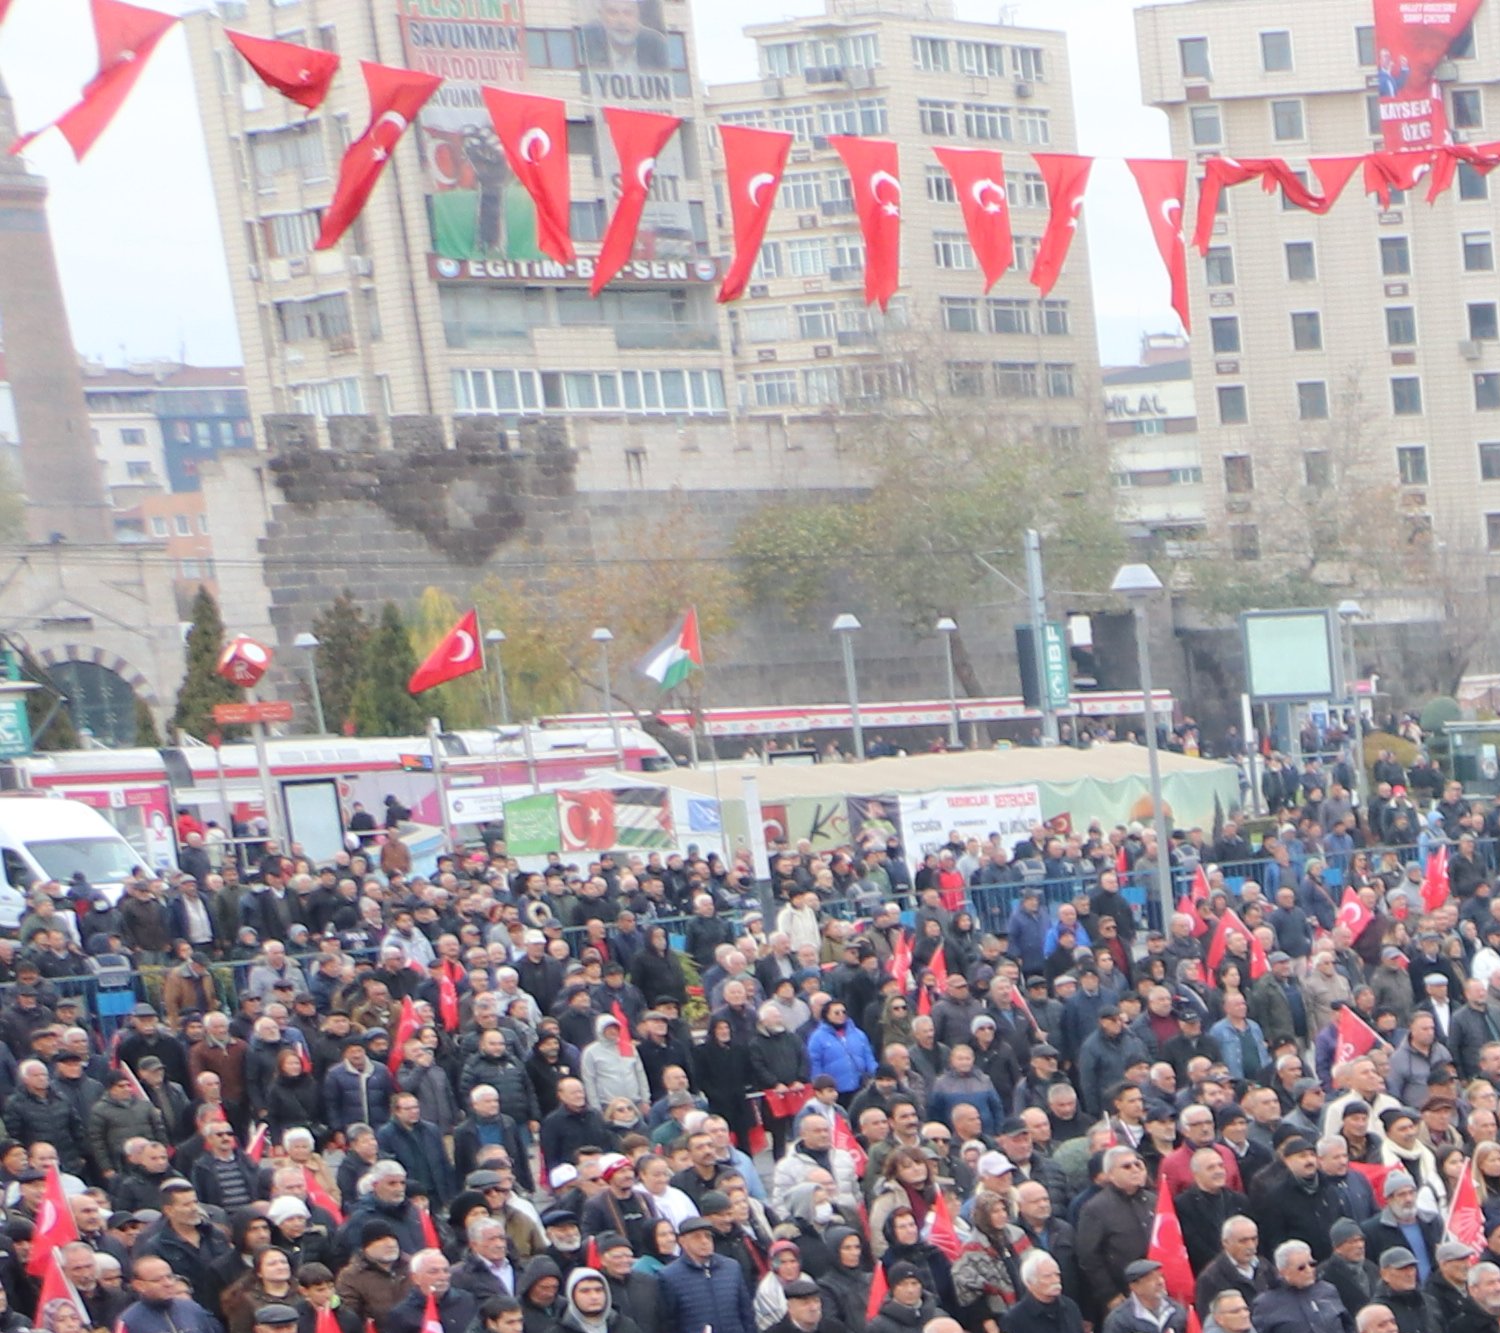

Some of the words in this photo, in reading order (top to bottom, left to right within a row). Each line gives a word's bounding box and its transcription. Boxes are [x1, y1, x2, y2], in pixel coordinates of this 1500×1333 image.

[596, 73, 673, 101] YOLUN
[1379, 99, 1432, 121] KAYSER
[469, 258, 687, 279] EĞİTİM-B-SEN
